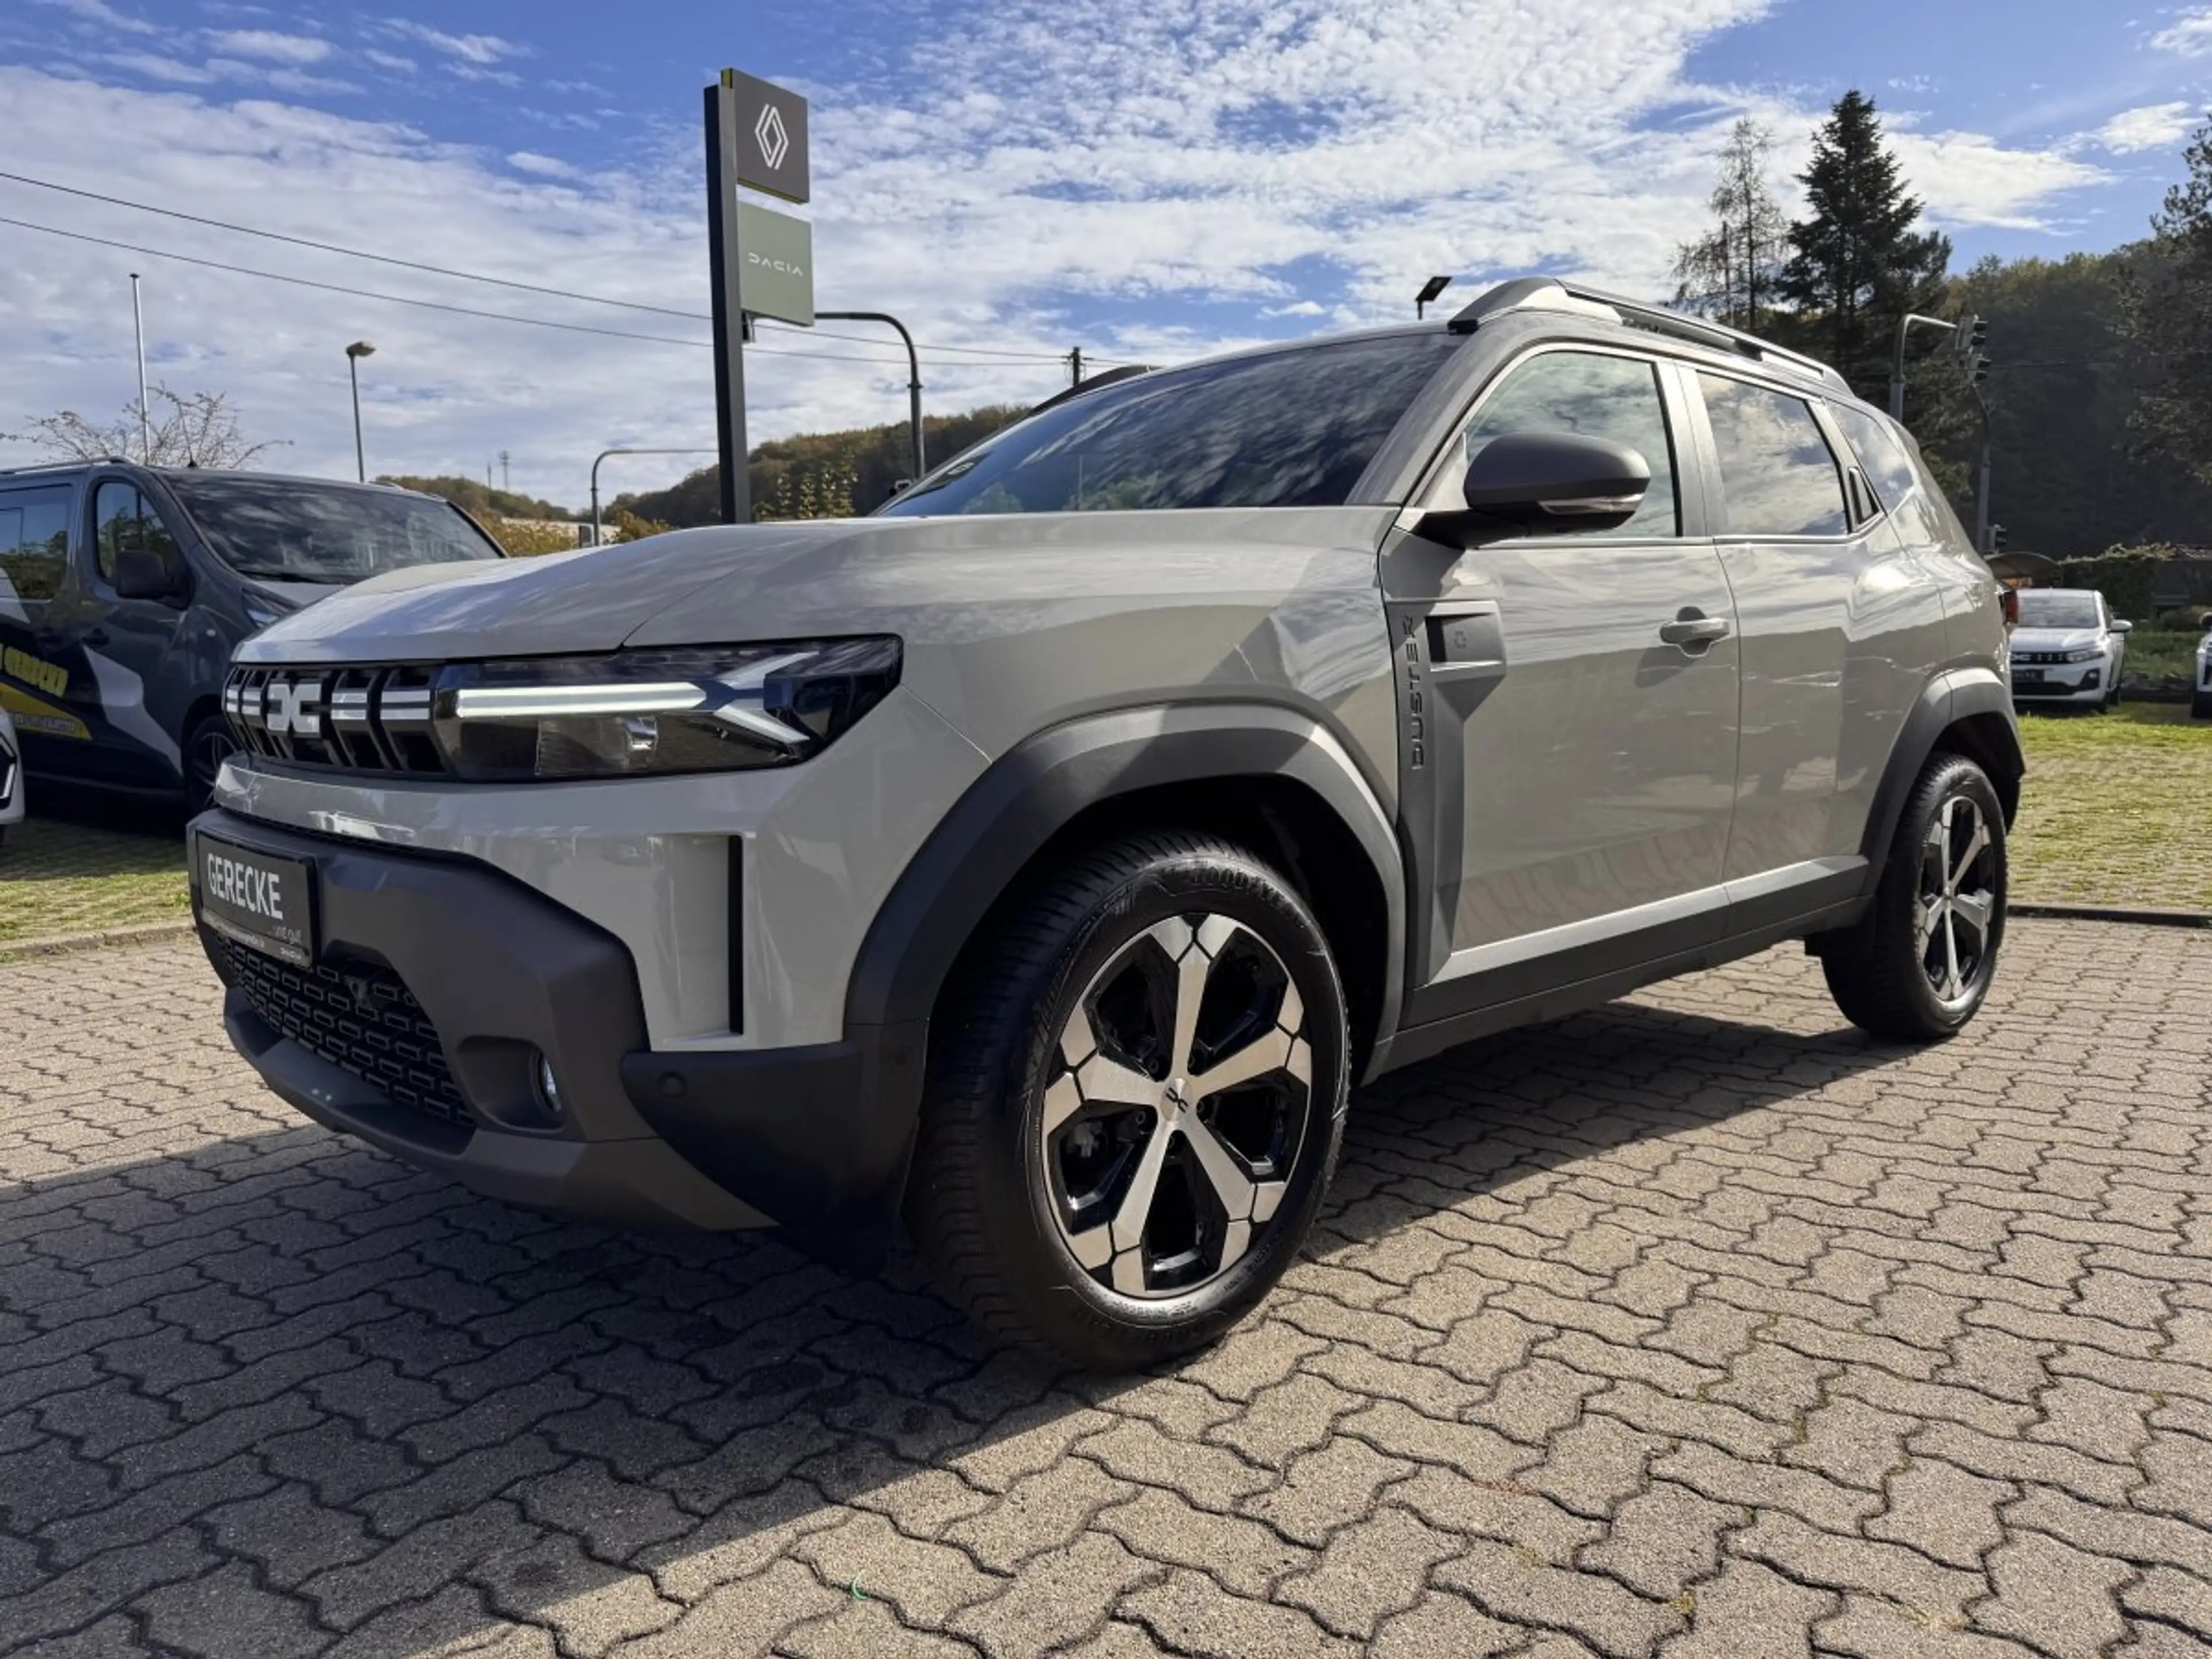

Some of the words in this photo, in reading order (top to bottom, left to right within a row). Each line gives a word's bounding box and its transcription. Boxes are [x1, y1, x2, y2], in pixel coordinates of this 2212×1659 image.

[748, 252, 803, 277] DACIA
[1403, 615, 1424, 769] DUSTER
[208, 853, 283, 920] GERECKE
